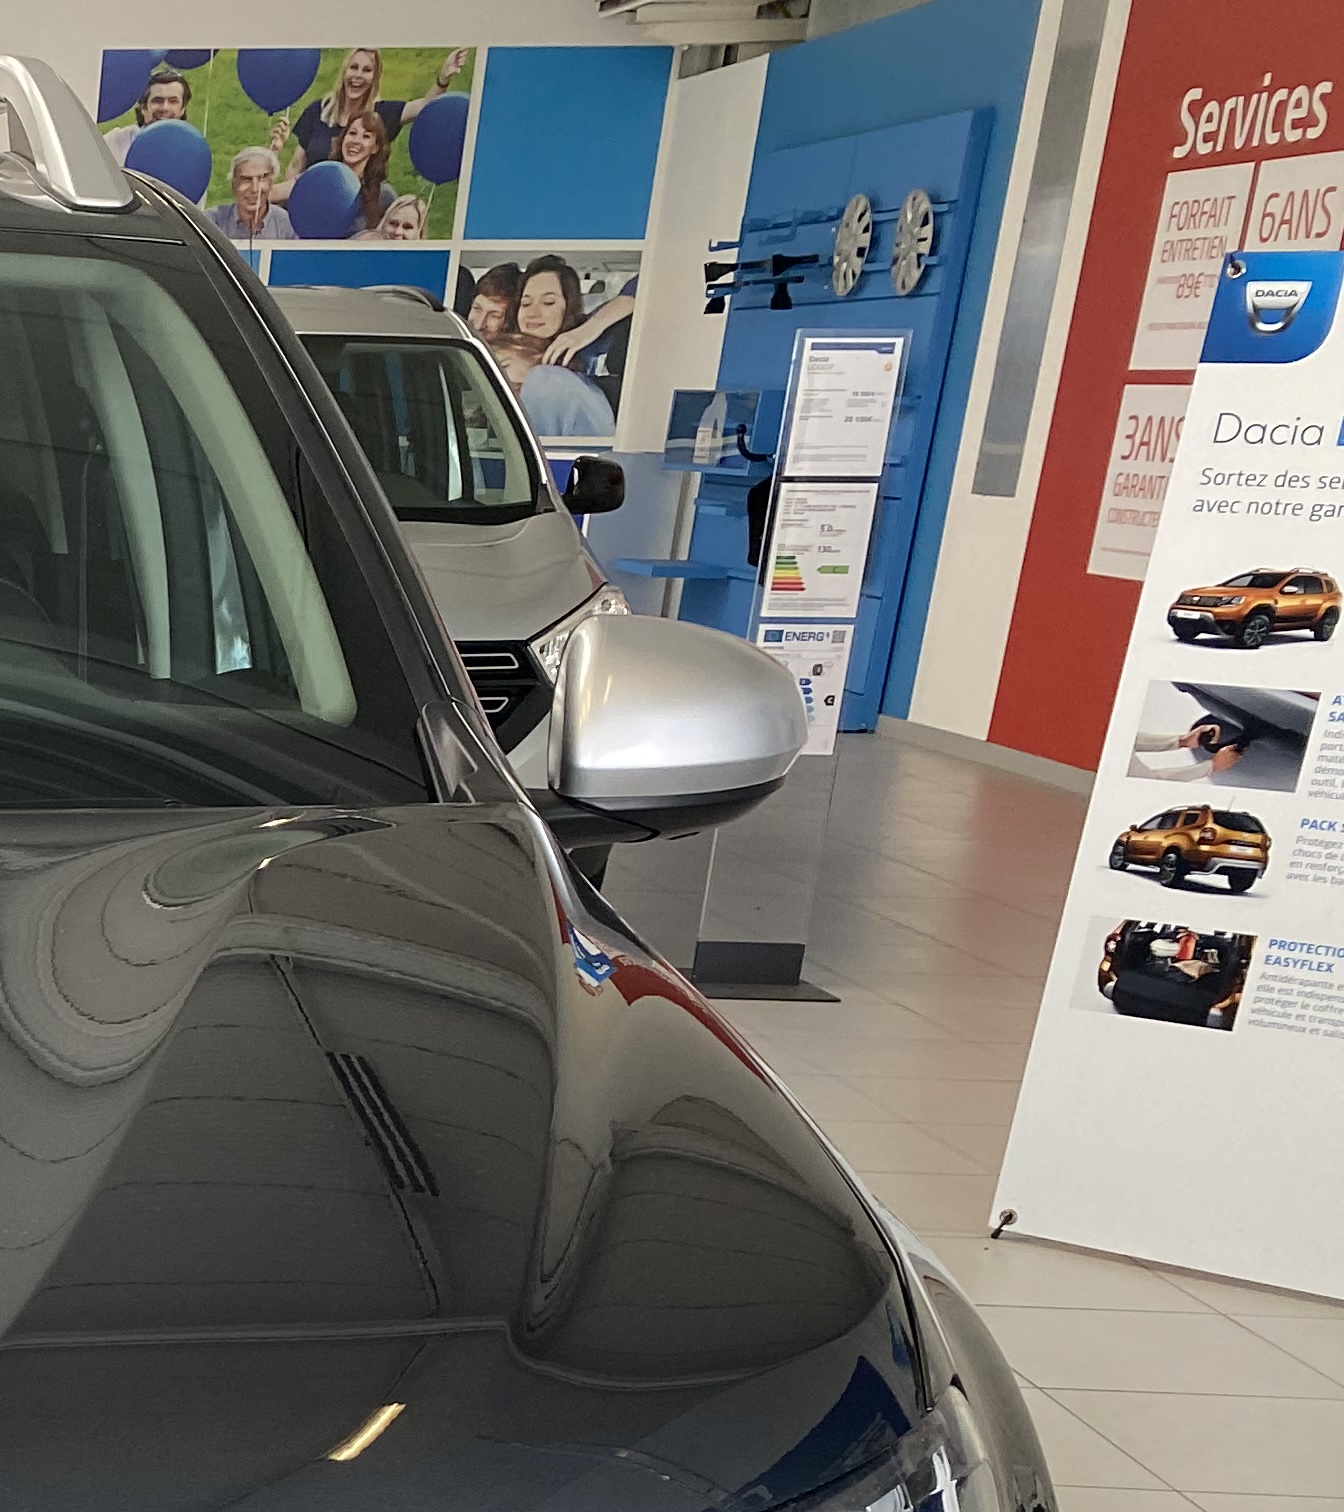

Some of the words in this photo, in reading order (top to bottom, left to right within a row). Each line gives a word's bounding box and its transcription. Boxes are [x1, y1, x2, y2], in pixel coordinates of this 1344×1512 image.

[1172, 72, 1334, 159] Services
[1166, 194, 1237, 232] FORFAIT
[1258, 186, 1338, 243] 6ANS
[1160, 235, 1229, 263] ENTRETIEN
[1254, 288, 1299, 299] DACIA
[1213, 412, 1325, 446] Dacia
[1199, 468, 1268, 488] Sortez
[1274, 470, 1311, 489] des
[1193, 499, 1240, 513] avec
[1246, 499, 1304, 516] notre
[784, 631, 825, 642] ENERG
[1299, 818, 1338, 832] PACK
[1263, 955, 1336, 973] EASYFLEX
